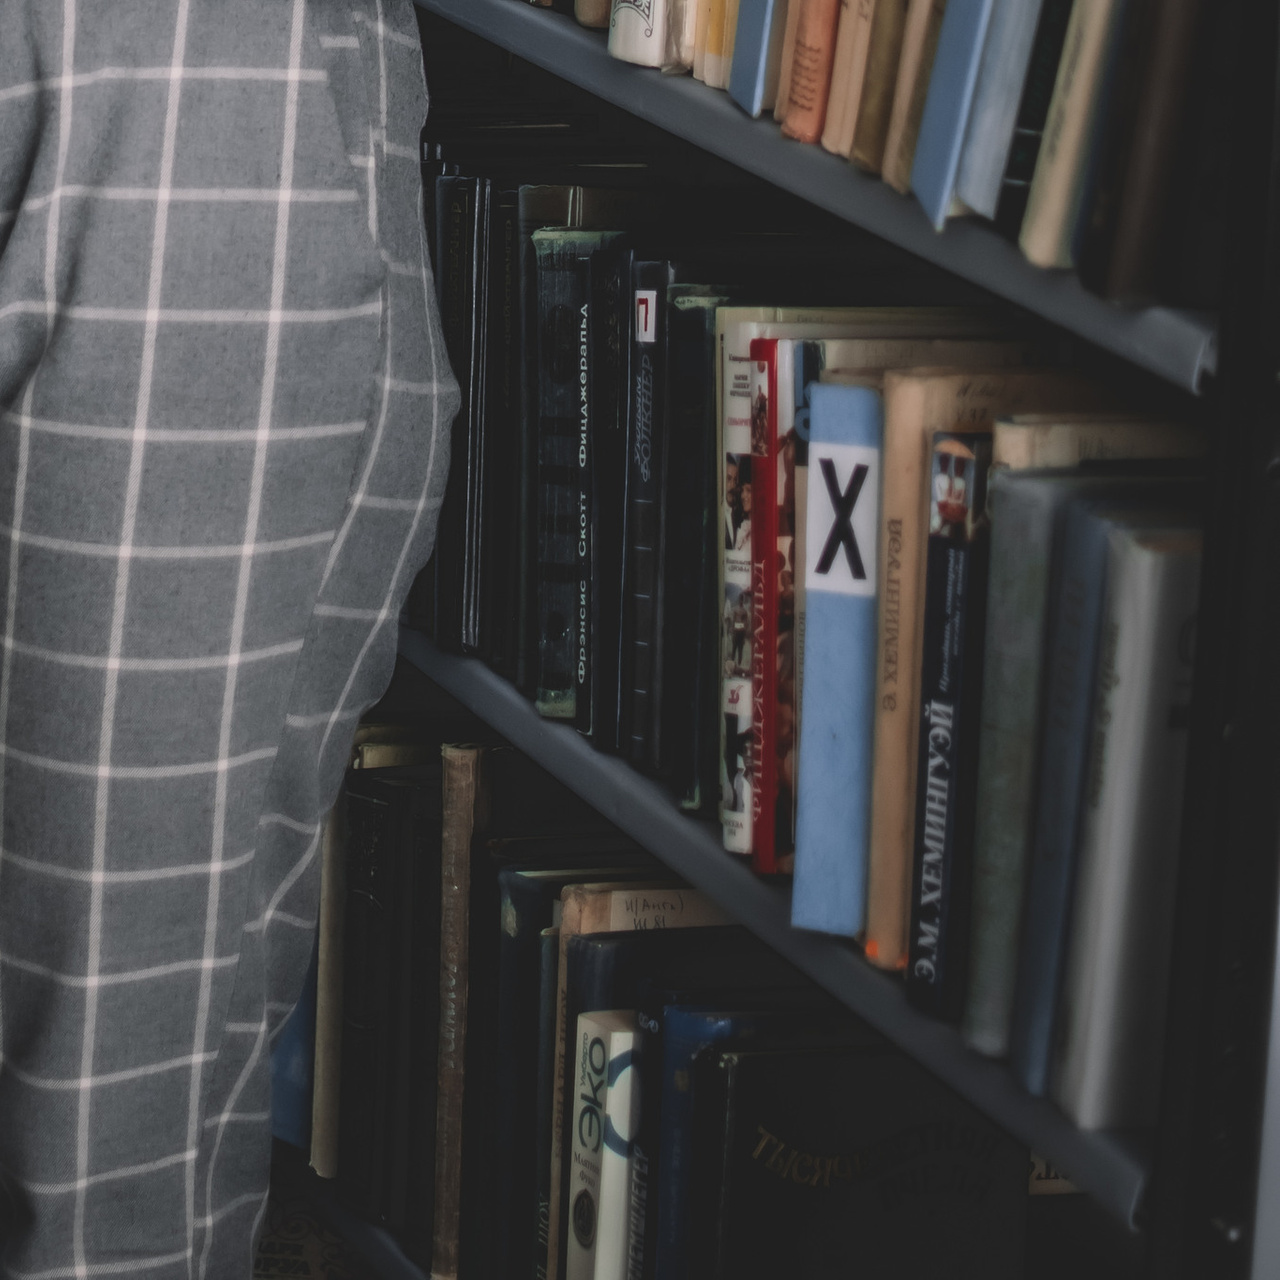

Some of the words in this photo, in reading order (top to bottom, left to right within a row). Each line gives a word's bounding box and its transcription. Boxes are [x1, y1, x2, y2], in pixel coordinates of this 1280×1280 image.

[578, 303, 590, 468] Фицджеральд
[640, 354, 654, 482] ФОЛКНЕР
[578, 492, 589, 558] Скотт
[815, 457, 869, 580] Х
[577, 580, 589, 684] Фрэнсис
[882, 519, 904, 682] ХЕМИНГУЭЙ
[753, 560, 767, 821] ФИЦДЖЕРАЛЬД
[919, 699, 954, 909] ХЕМИНГУЭЙ
[914, 919, 940, 984] Э.М.
[579, 1036, 605, 1154] ЭКО
[580, 1032, 591, 1088] Умберто
